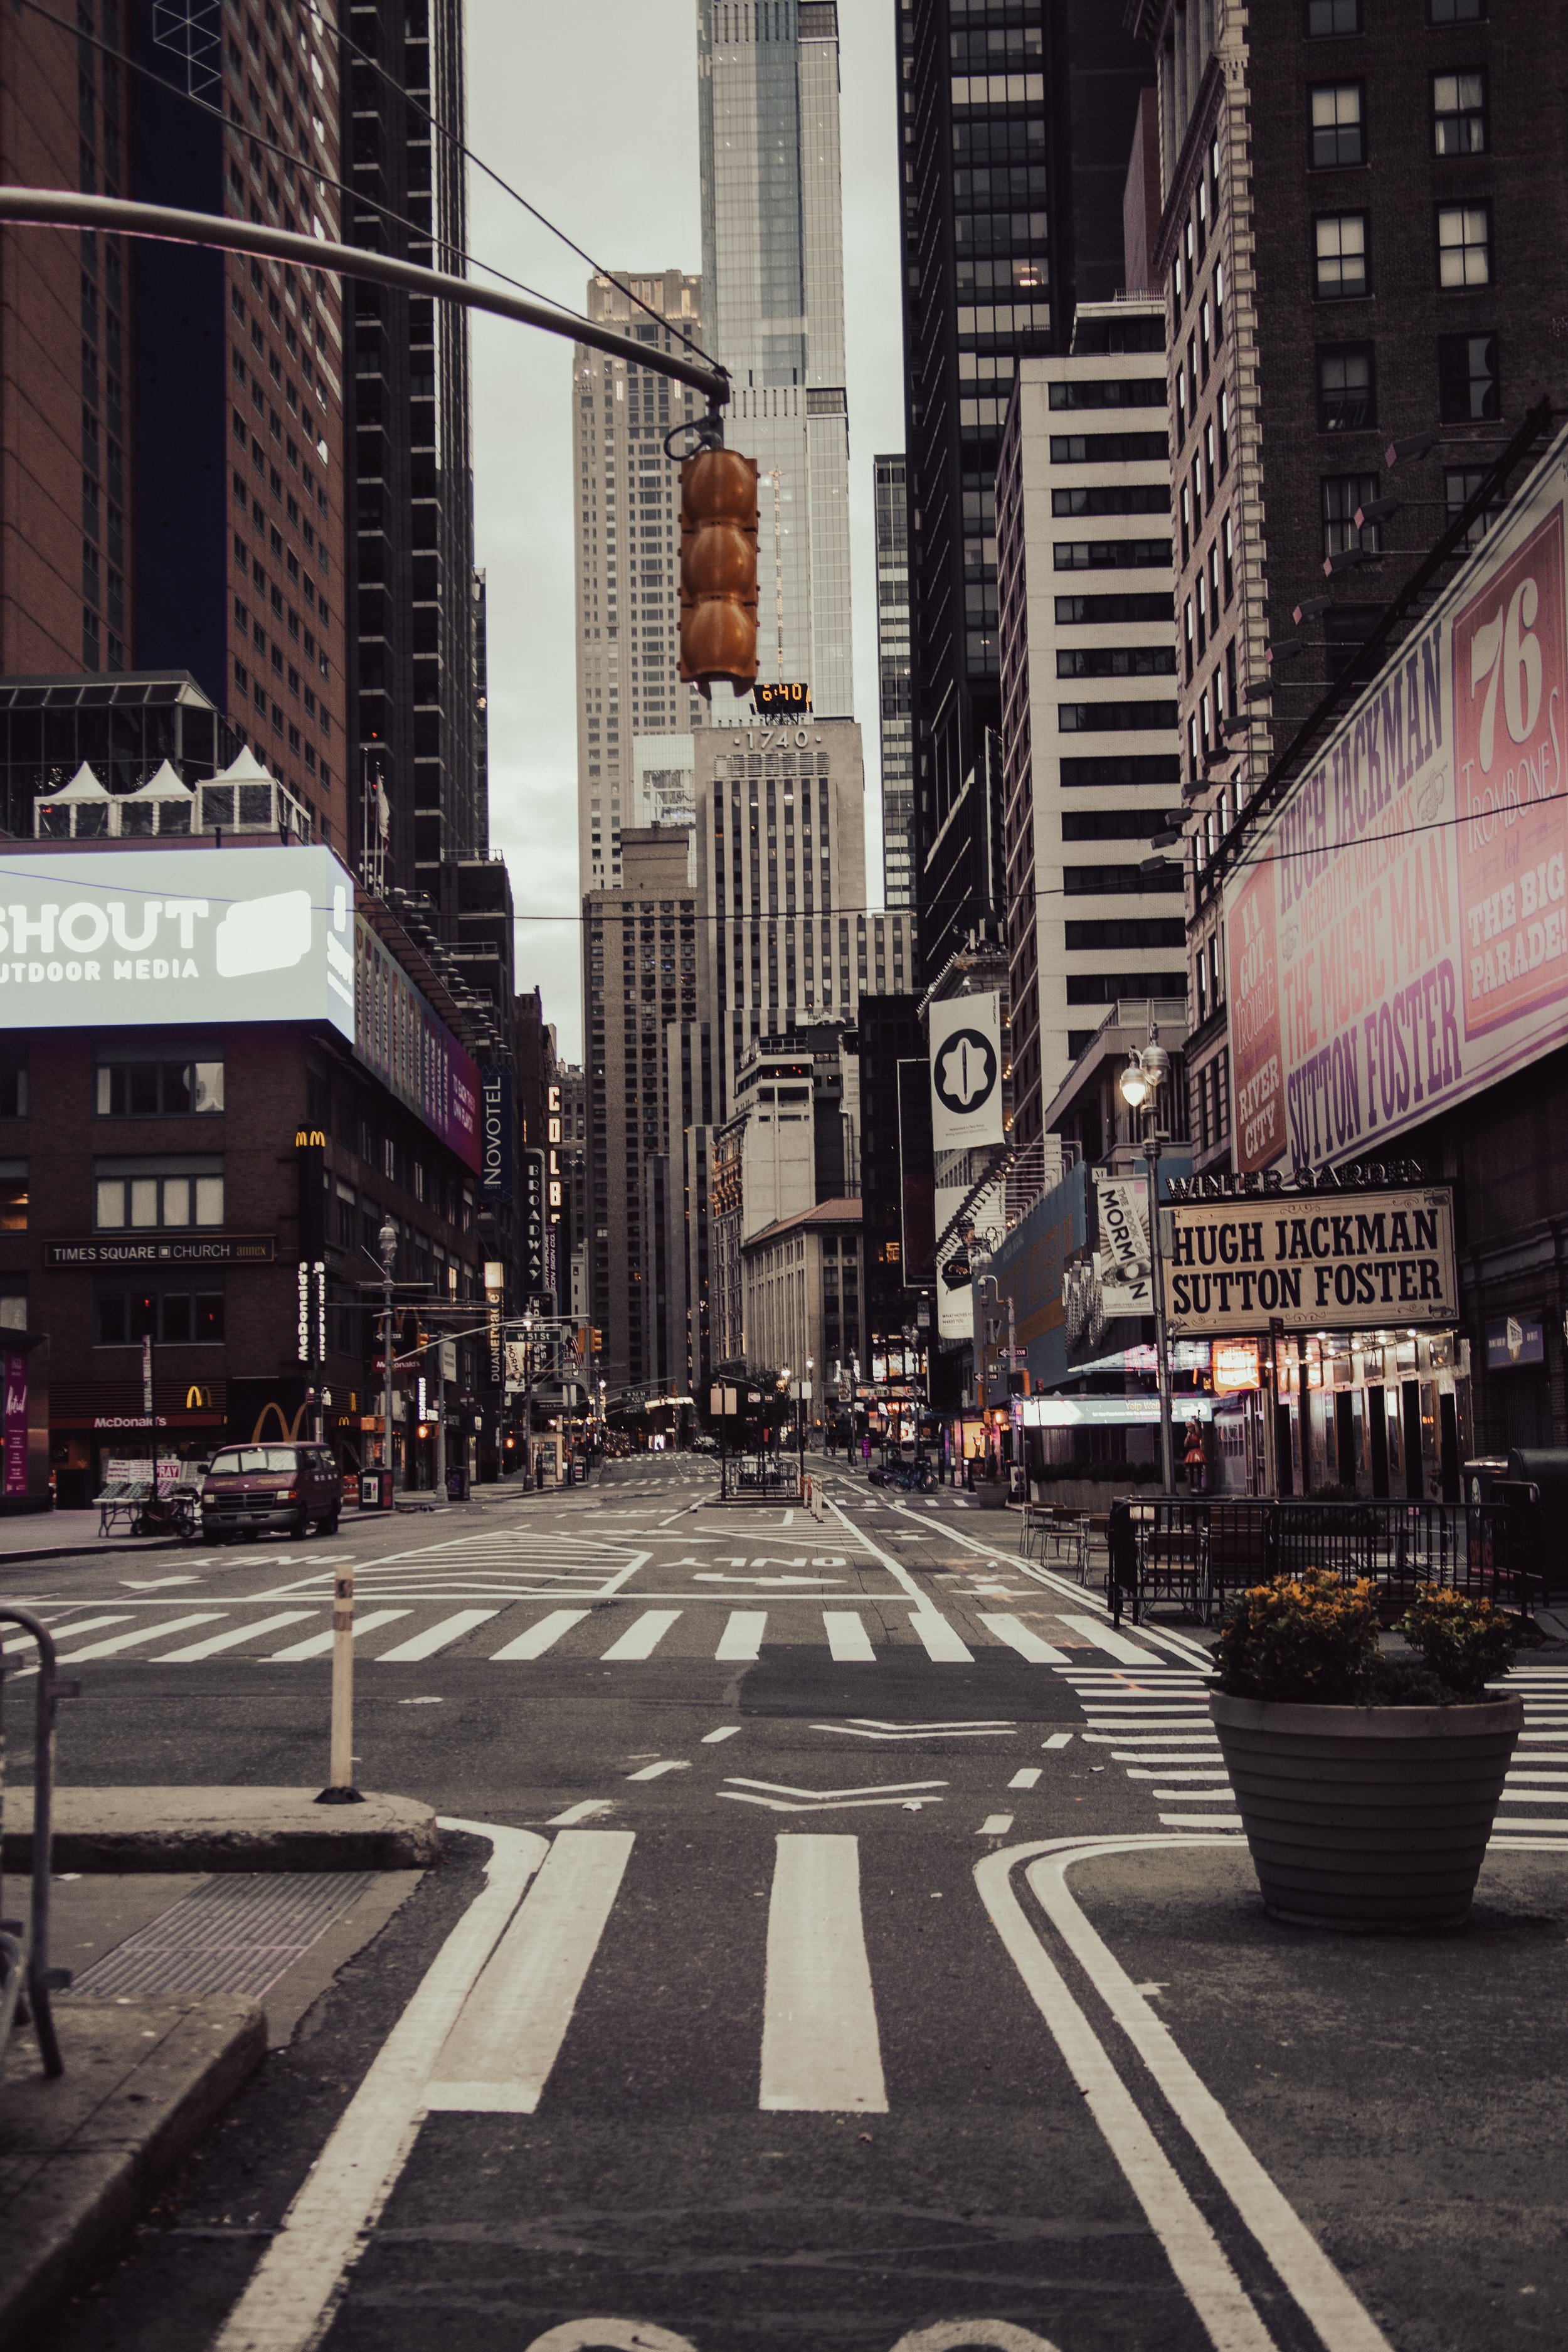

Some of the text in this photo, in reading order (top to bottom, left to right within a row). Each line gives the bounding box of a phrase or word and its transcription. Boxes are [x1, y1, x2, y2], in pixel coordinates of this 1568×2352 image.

[762, 682, 802, 701] 6:40
[1471, 578, 1543, 774] 76
[747, 729, 808, 749] 1740
[1278, 619, 1442, 917] HUGH JACKMAN
[1462, 686, 1561, 855] TROMBONES
[1300, 785, 1415, 950] MEREDITH WILLSON'S
[1468, 851, 1566, 950] THE BIG
[0, 901, 209, 953] HOUT
[1283, 824, 1452, 1067] THE MUSIC MAN
[1470, 906, 1568, 1002] PARADE!
[114, 958, 199, 979] MEDIA
[1240, 928, 1266, 1001] GOT
[1236, 956, 1275, 1055] TROUBLE
[1238, 1054, 1279, 1126] RIVER
[1288, 957, 1463, 1173] SUTTON FOSTER
[484, 1076, 501, 1185] NOVOTEL
[1244, 1099, 1276, 1160] CITY
[1165, 1159, 1426, 1199] WINTER GARDEN
[53, 1244, 267, 1261] TIMES SQUARE CHURCH annex
[527, 1165, 541, 1280] BROADWAY
[1116, 1186, 1145, 1258] THE BOOK OF
[1172, 1209, 1438, 1266] HUGH JACKMAN
[298, 1261, 309, 1362] McDonald's
[1172, 1258, 1443, 1315] SUTTON FOSTER
[541, 1332, 550, 1340] St
[659, 1557, 847, 1567] ONLY
